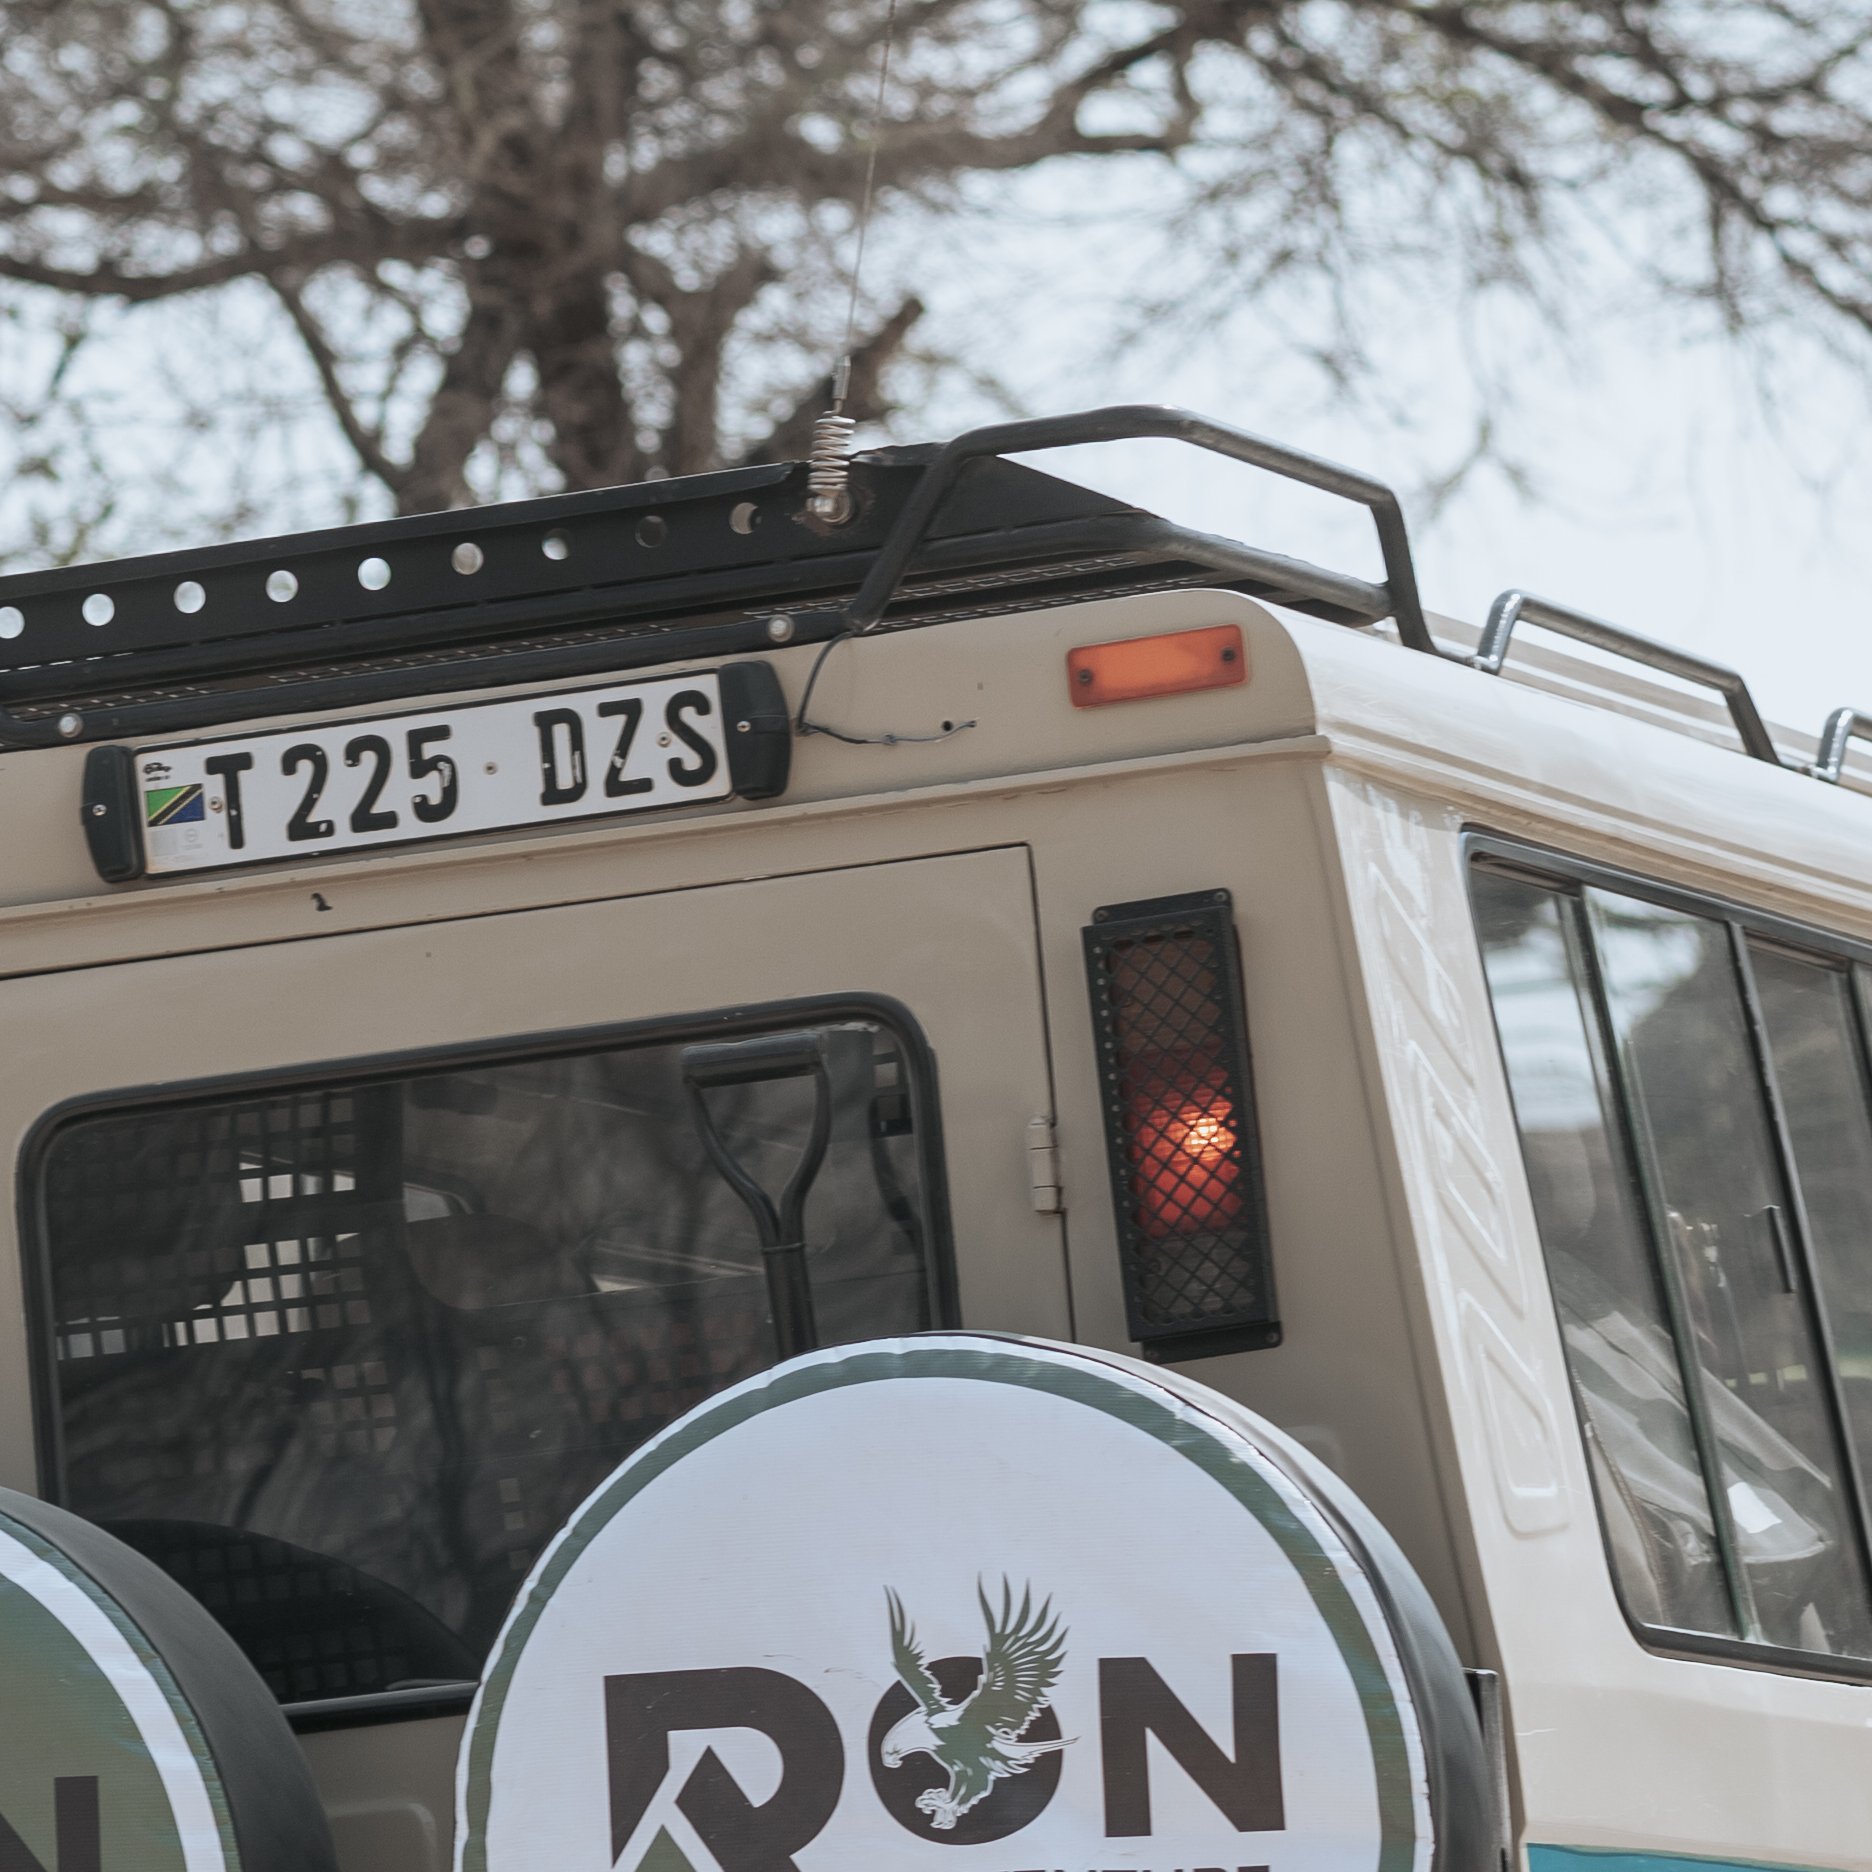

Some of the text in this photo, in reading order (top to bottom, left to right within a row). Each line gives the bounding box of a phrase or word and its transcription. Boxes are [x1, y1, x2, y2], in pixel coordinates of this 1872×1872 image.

[205, 689, 716, 850] T 225 DZS
